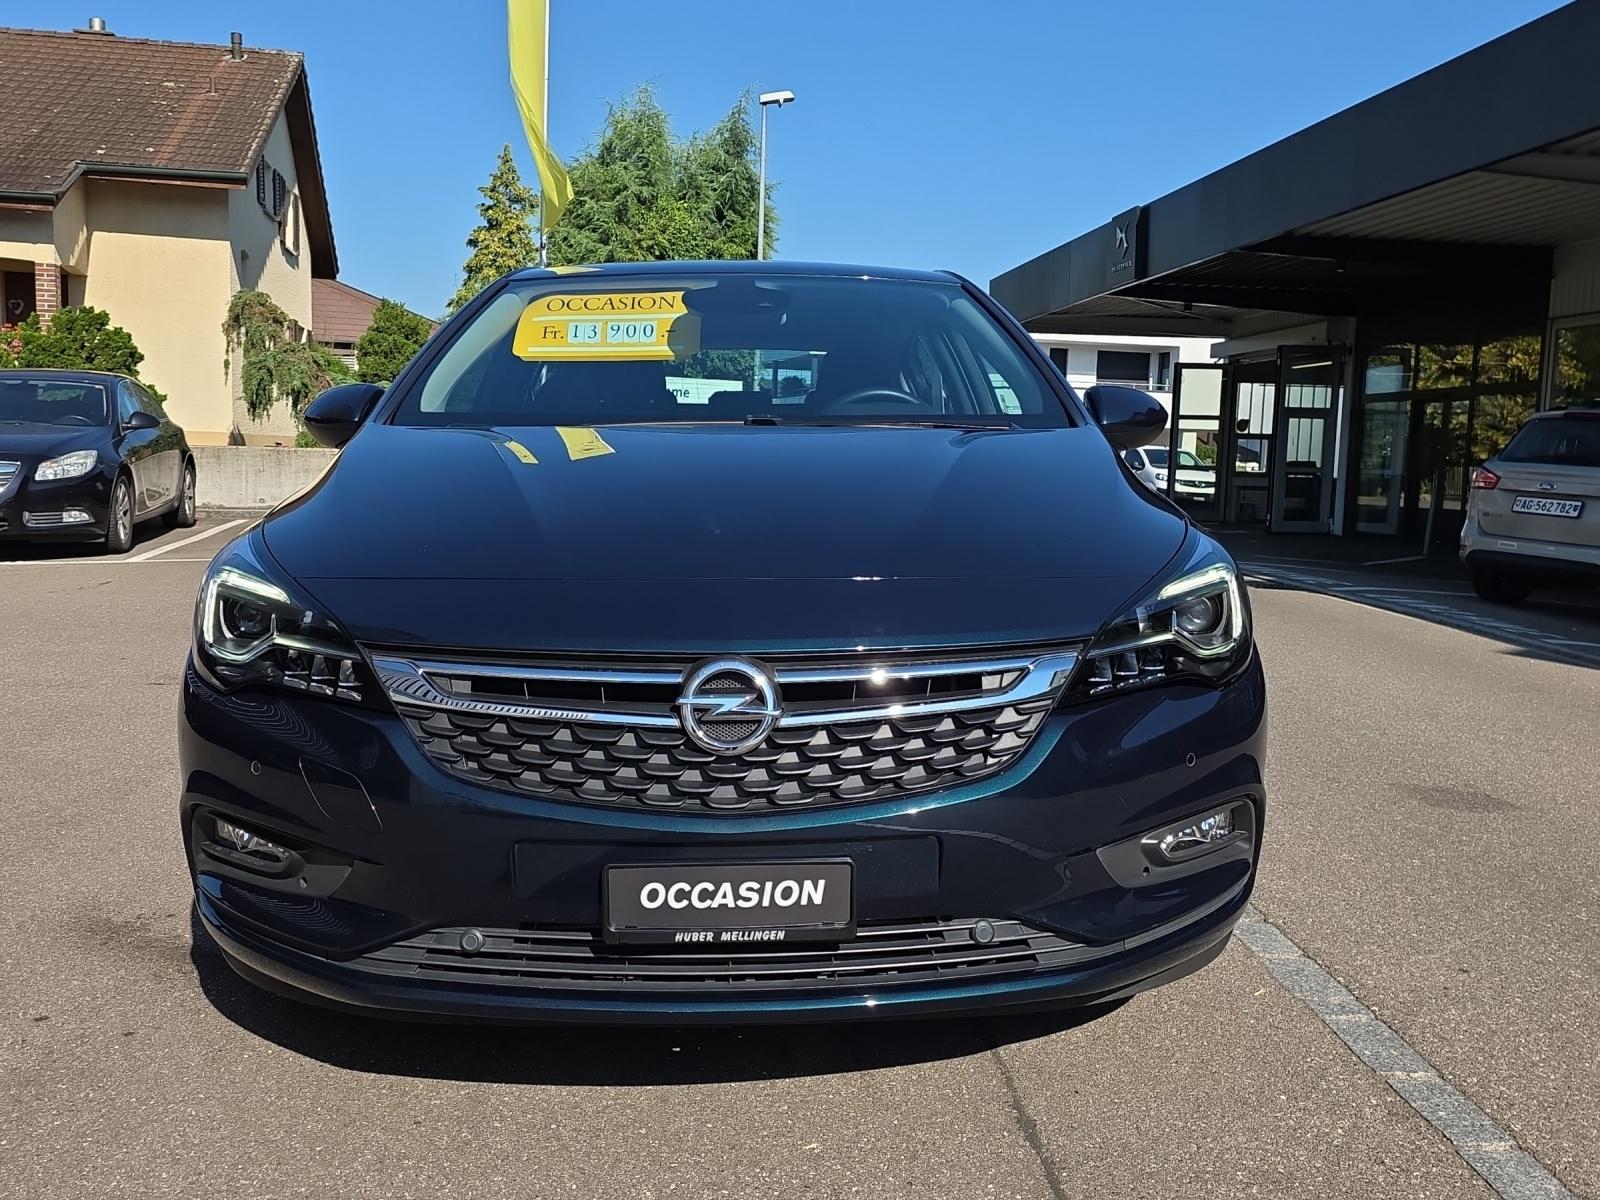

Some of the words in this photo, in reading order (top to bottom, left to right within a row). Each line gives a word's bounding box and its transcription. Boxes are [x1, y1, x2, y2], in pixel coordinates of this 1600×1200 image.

[546, 296, 676, 311] OCCASION
[542, 325, 564, 340] Fr.
[639, 879, 826, 910] OCCASION
[674, 931, 714, 943] HUBER
[720, 930, 786, 942] MELLINGEN
